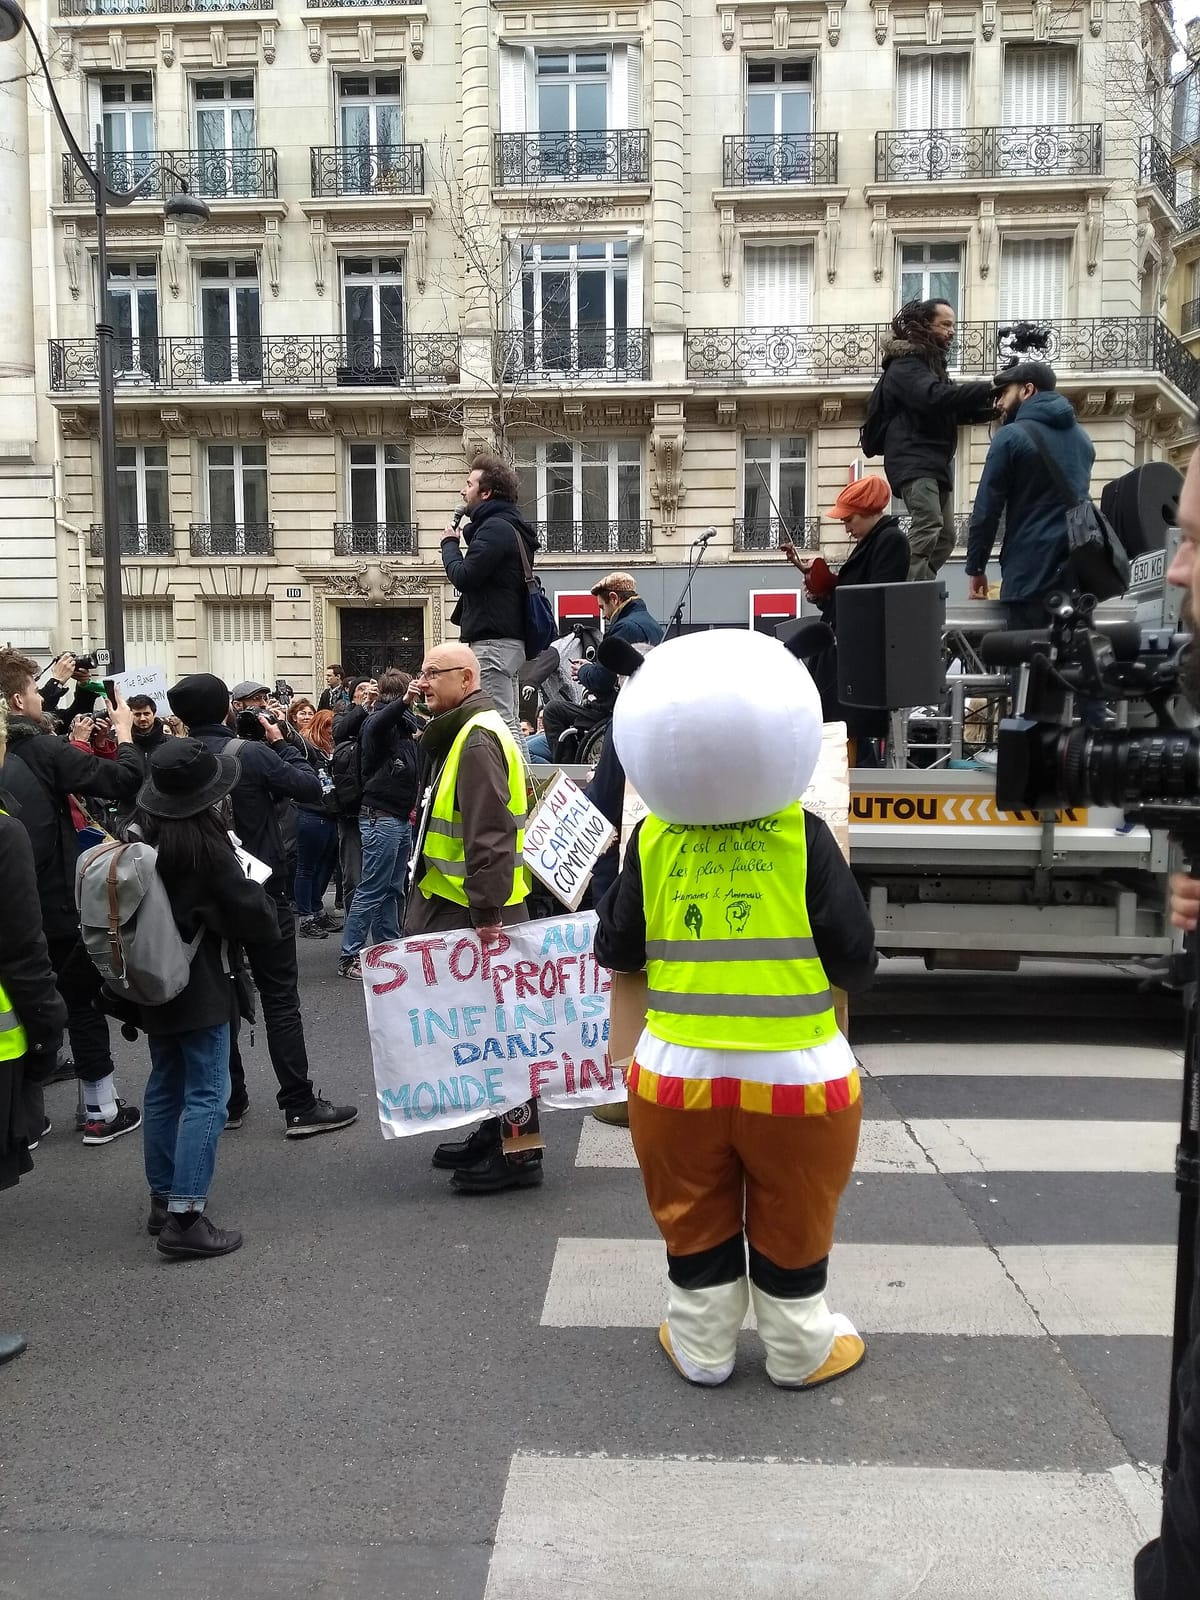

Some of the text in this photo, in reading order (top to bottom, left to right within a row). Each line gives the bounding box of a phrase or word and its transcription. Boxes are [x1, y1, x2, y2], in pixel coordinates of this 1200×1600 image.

[1151, 557, 1162, 577] KG
[522, 819, 551, 857] NON
[550, 789, 568, 817] AU
[848, 797, 937, 820] UTOU
[696, 861, 725, 884] plus
[729, 856, 774, 882] faibles
[365, 933, 512, 997] STOP
[453, 1031, 556, 1067] DANS
[380, 1067, 507, 1121] MONDE
